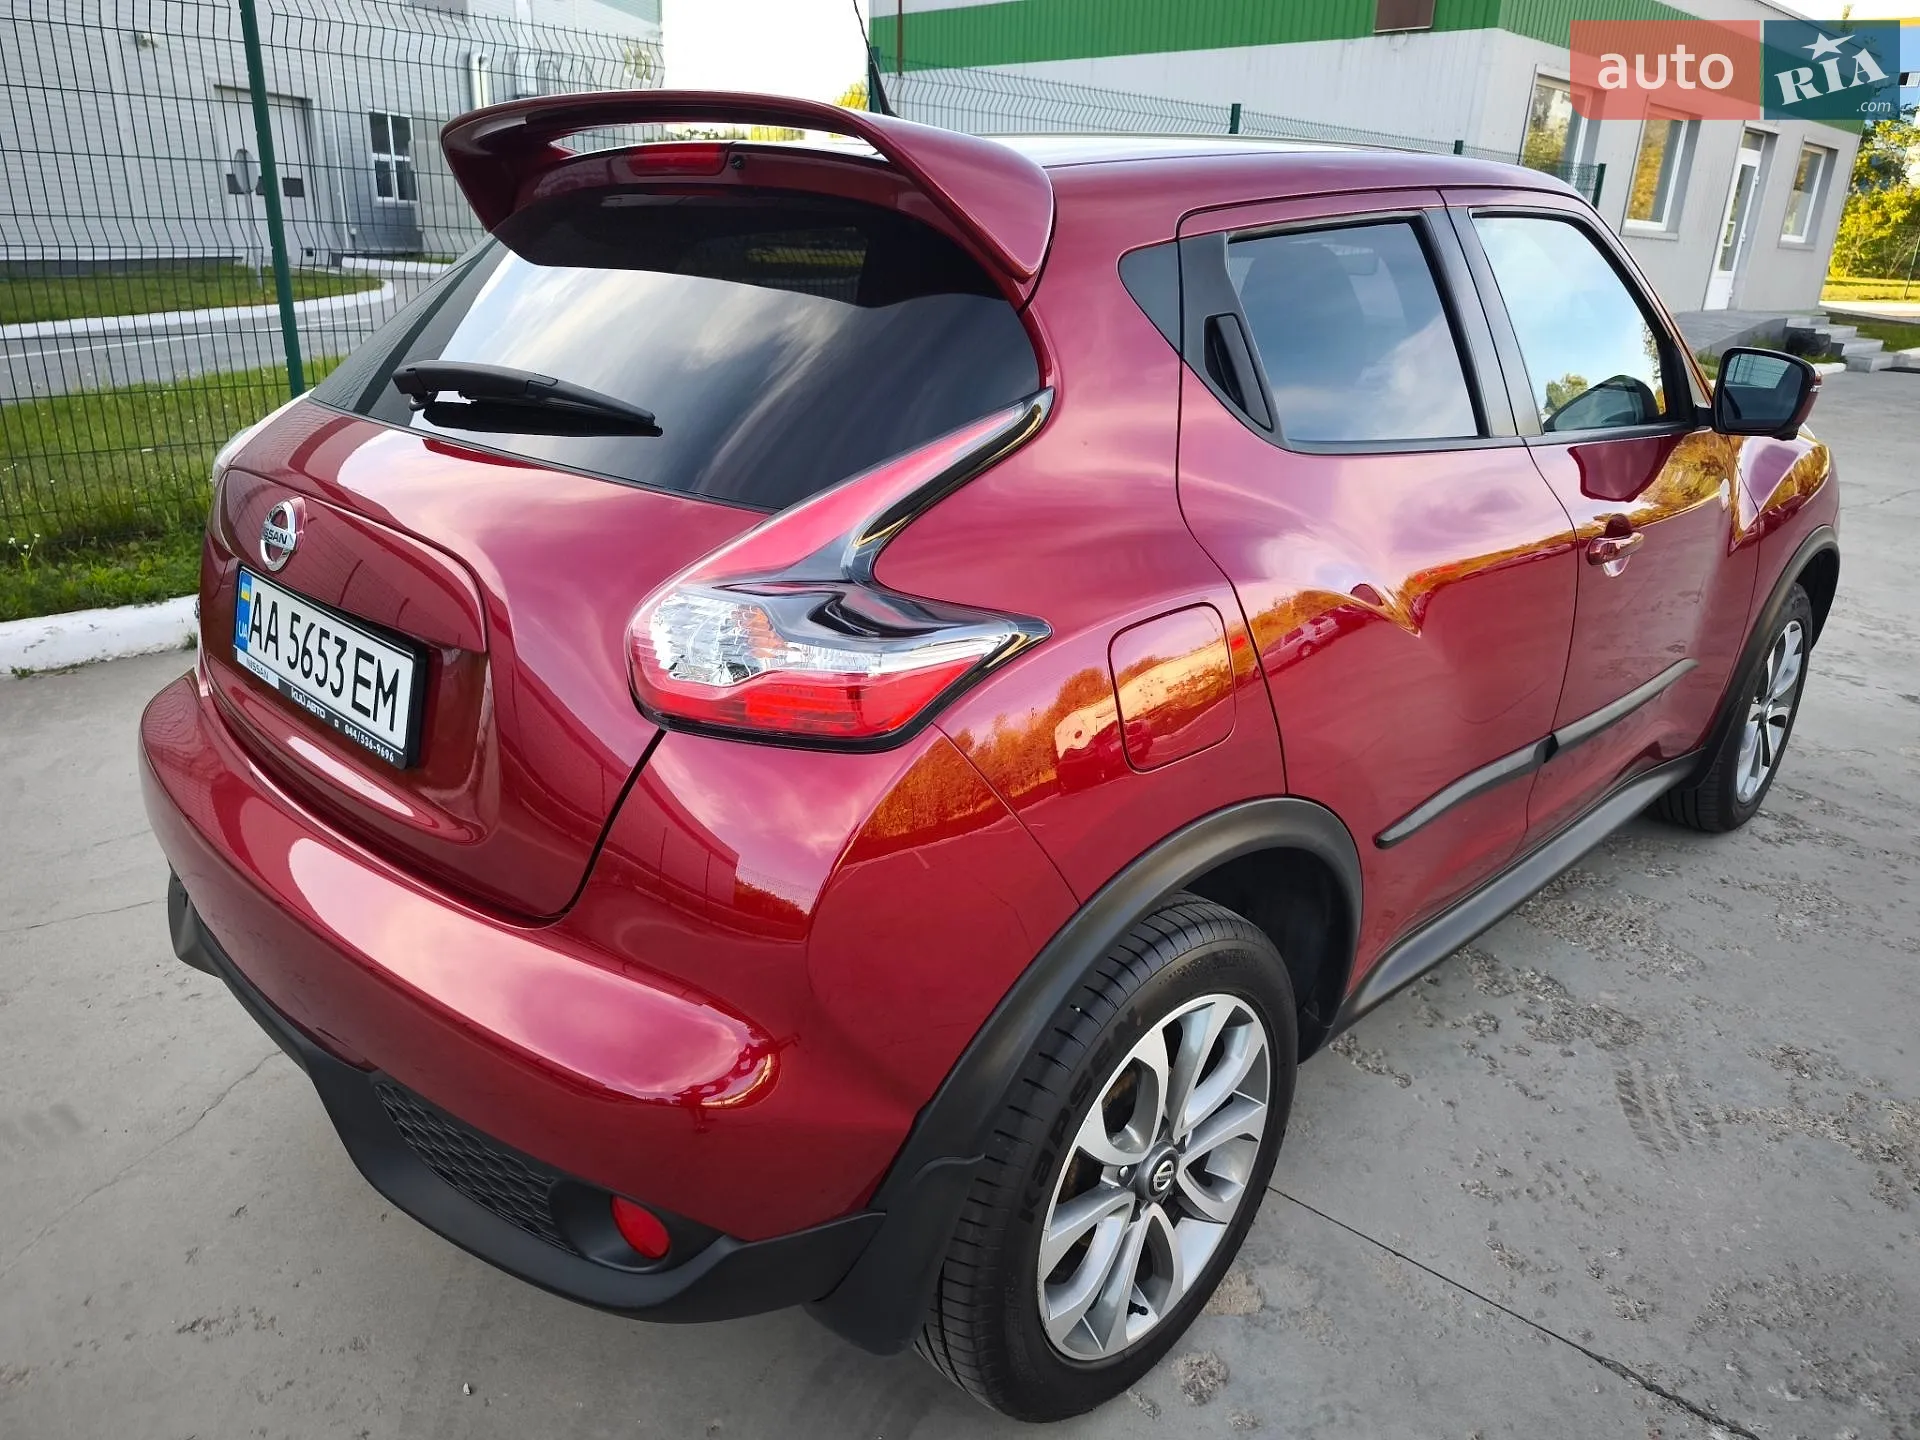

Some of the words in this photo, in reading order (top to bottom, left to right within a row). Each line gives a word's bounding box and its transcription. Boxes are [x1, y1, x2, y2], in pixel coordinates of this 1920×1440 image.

[238, 620, 248, 640] UA
[249, 592, 279, 661] AA
[287, 611, 347, 698] 5653
[351, 647, 399, 732] EM
